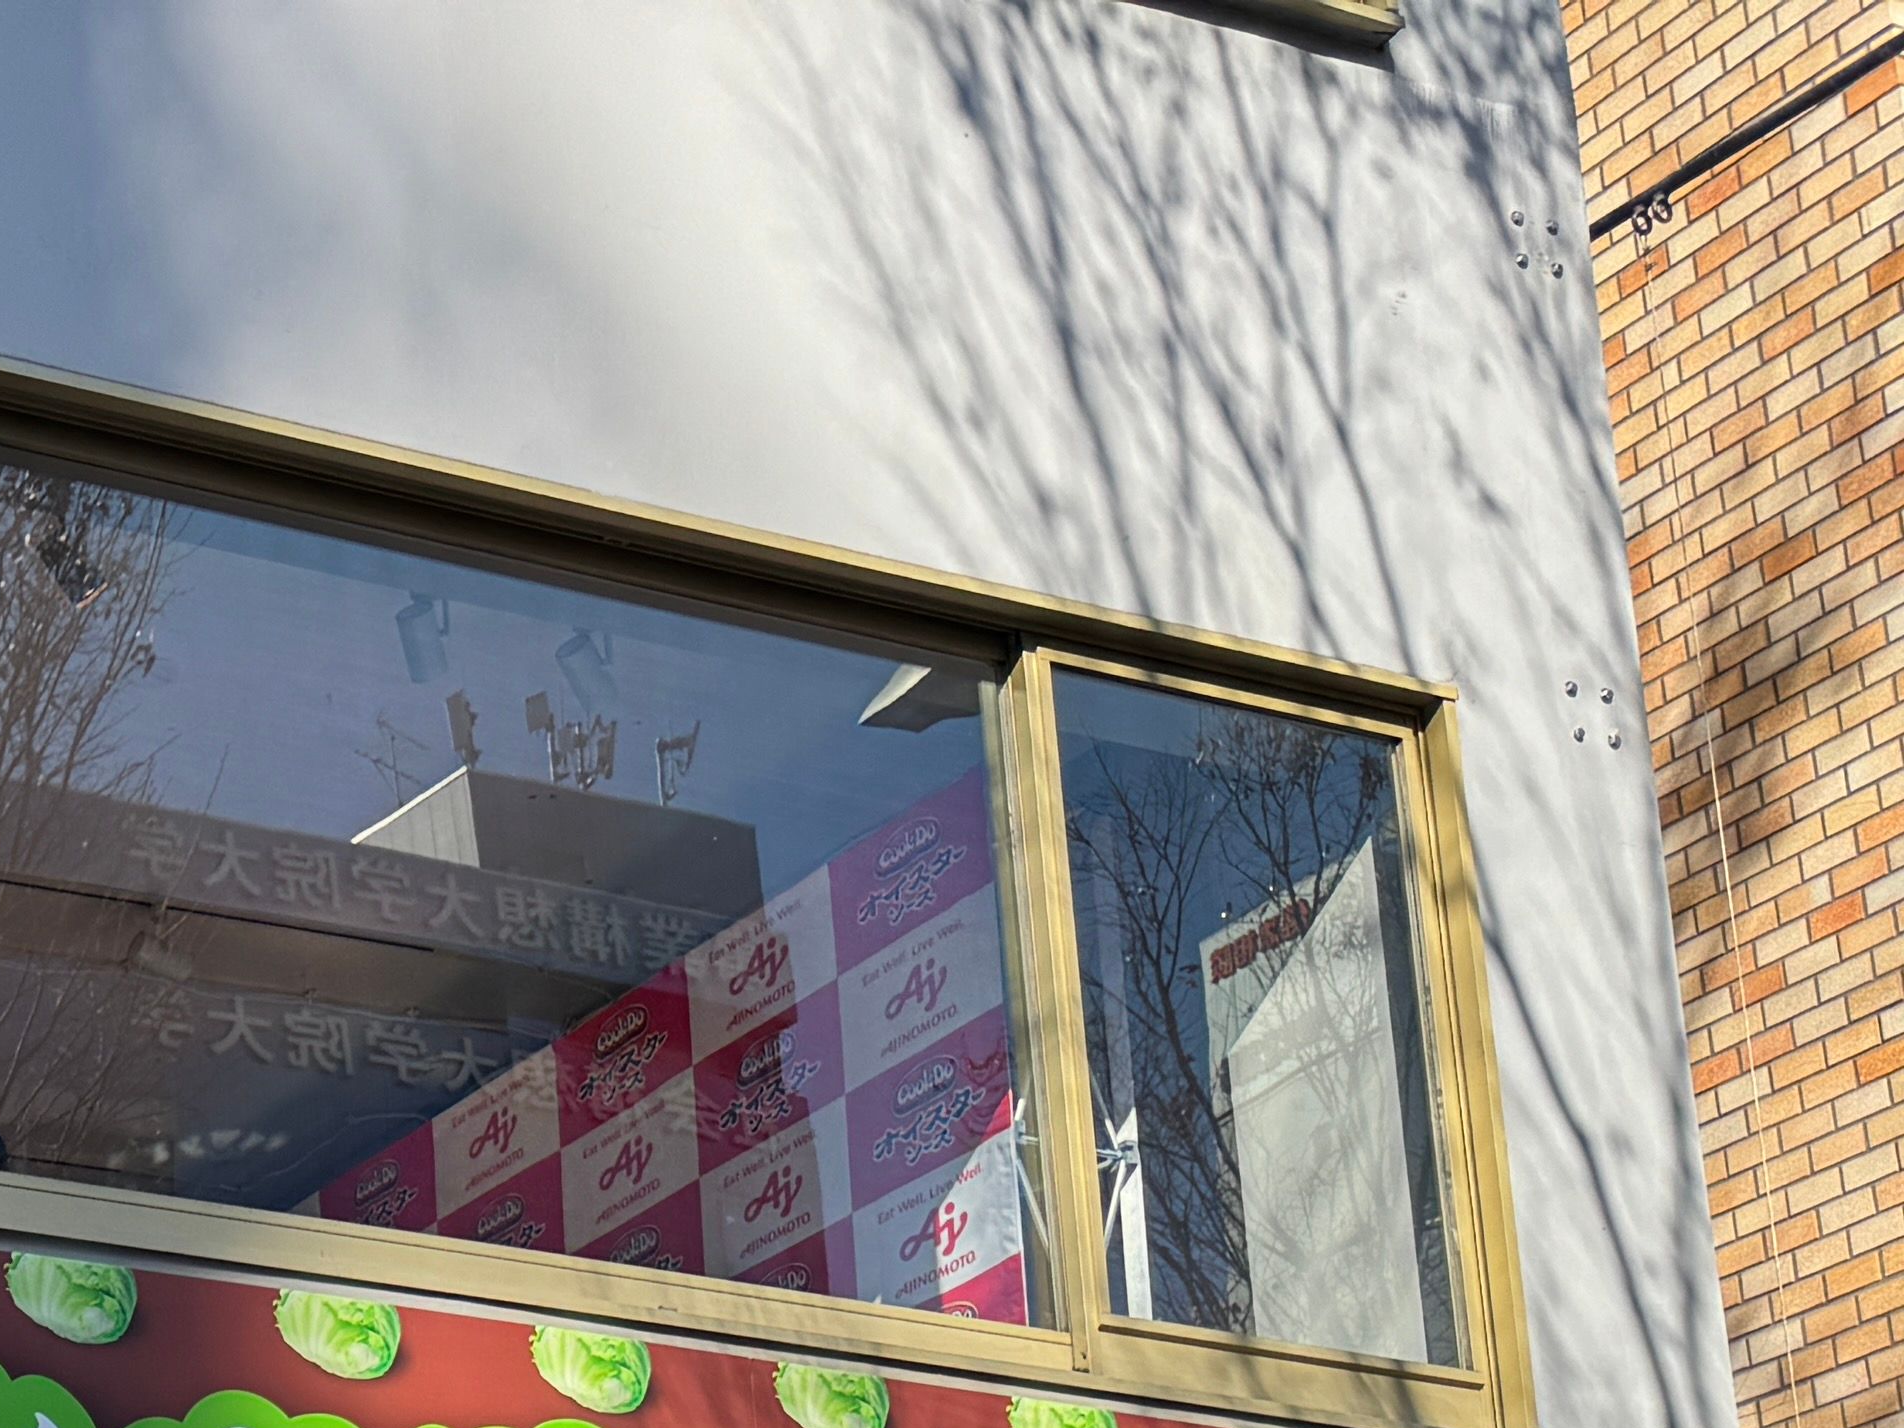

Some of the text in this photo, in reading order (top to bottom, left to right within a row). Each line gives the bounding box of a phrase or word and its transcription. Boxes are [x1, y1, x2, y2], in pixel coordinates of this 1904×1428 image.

[872, 1086, 987, 1163] オイスター
[739, 1211, 812, 1261] AJINOMOTO
